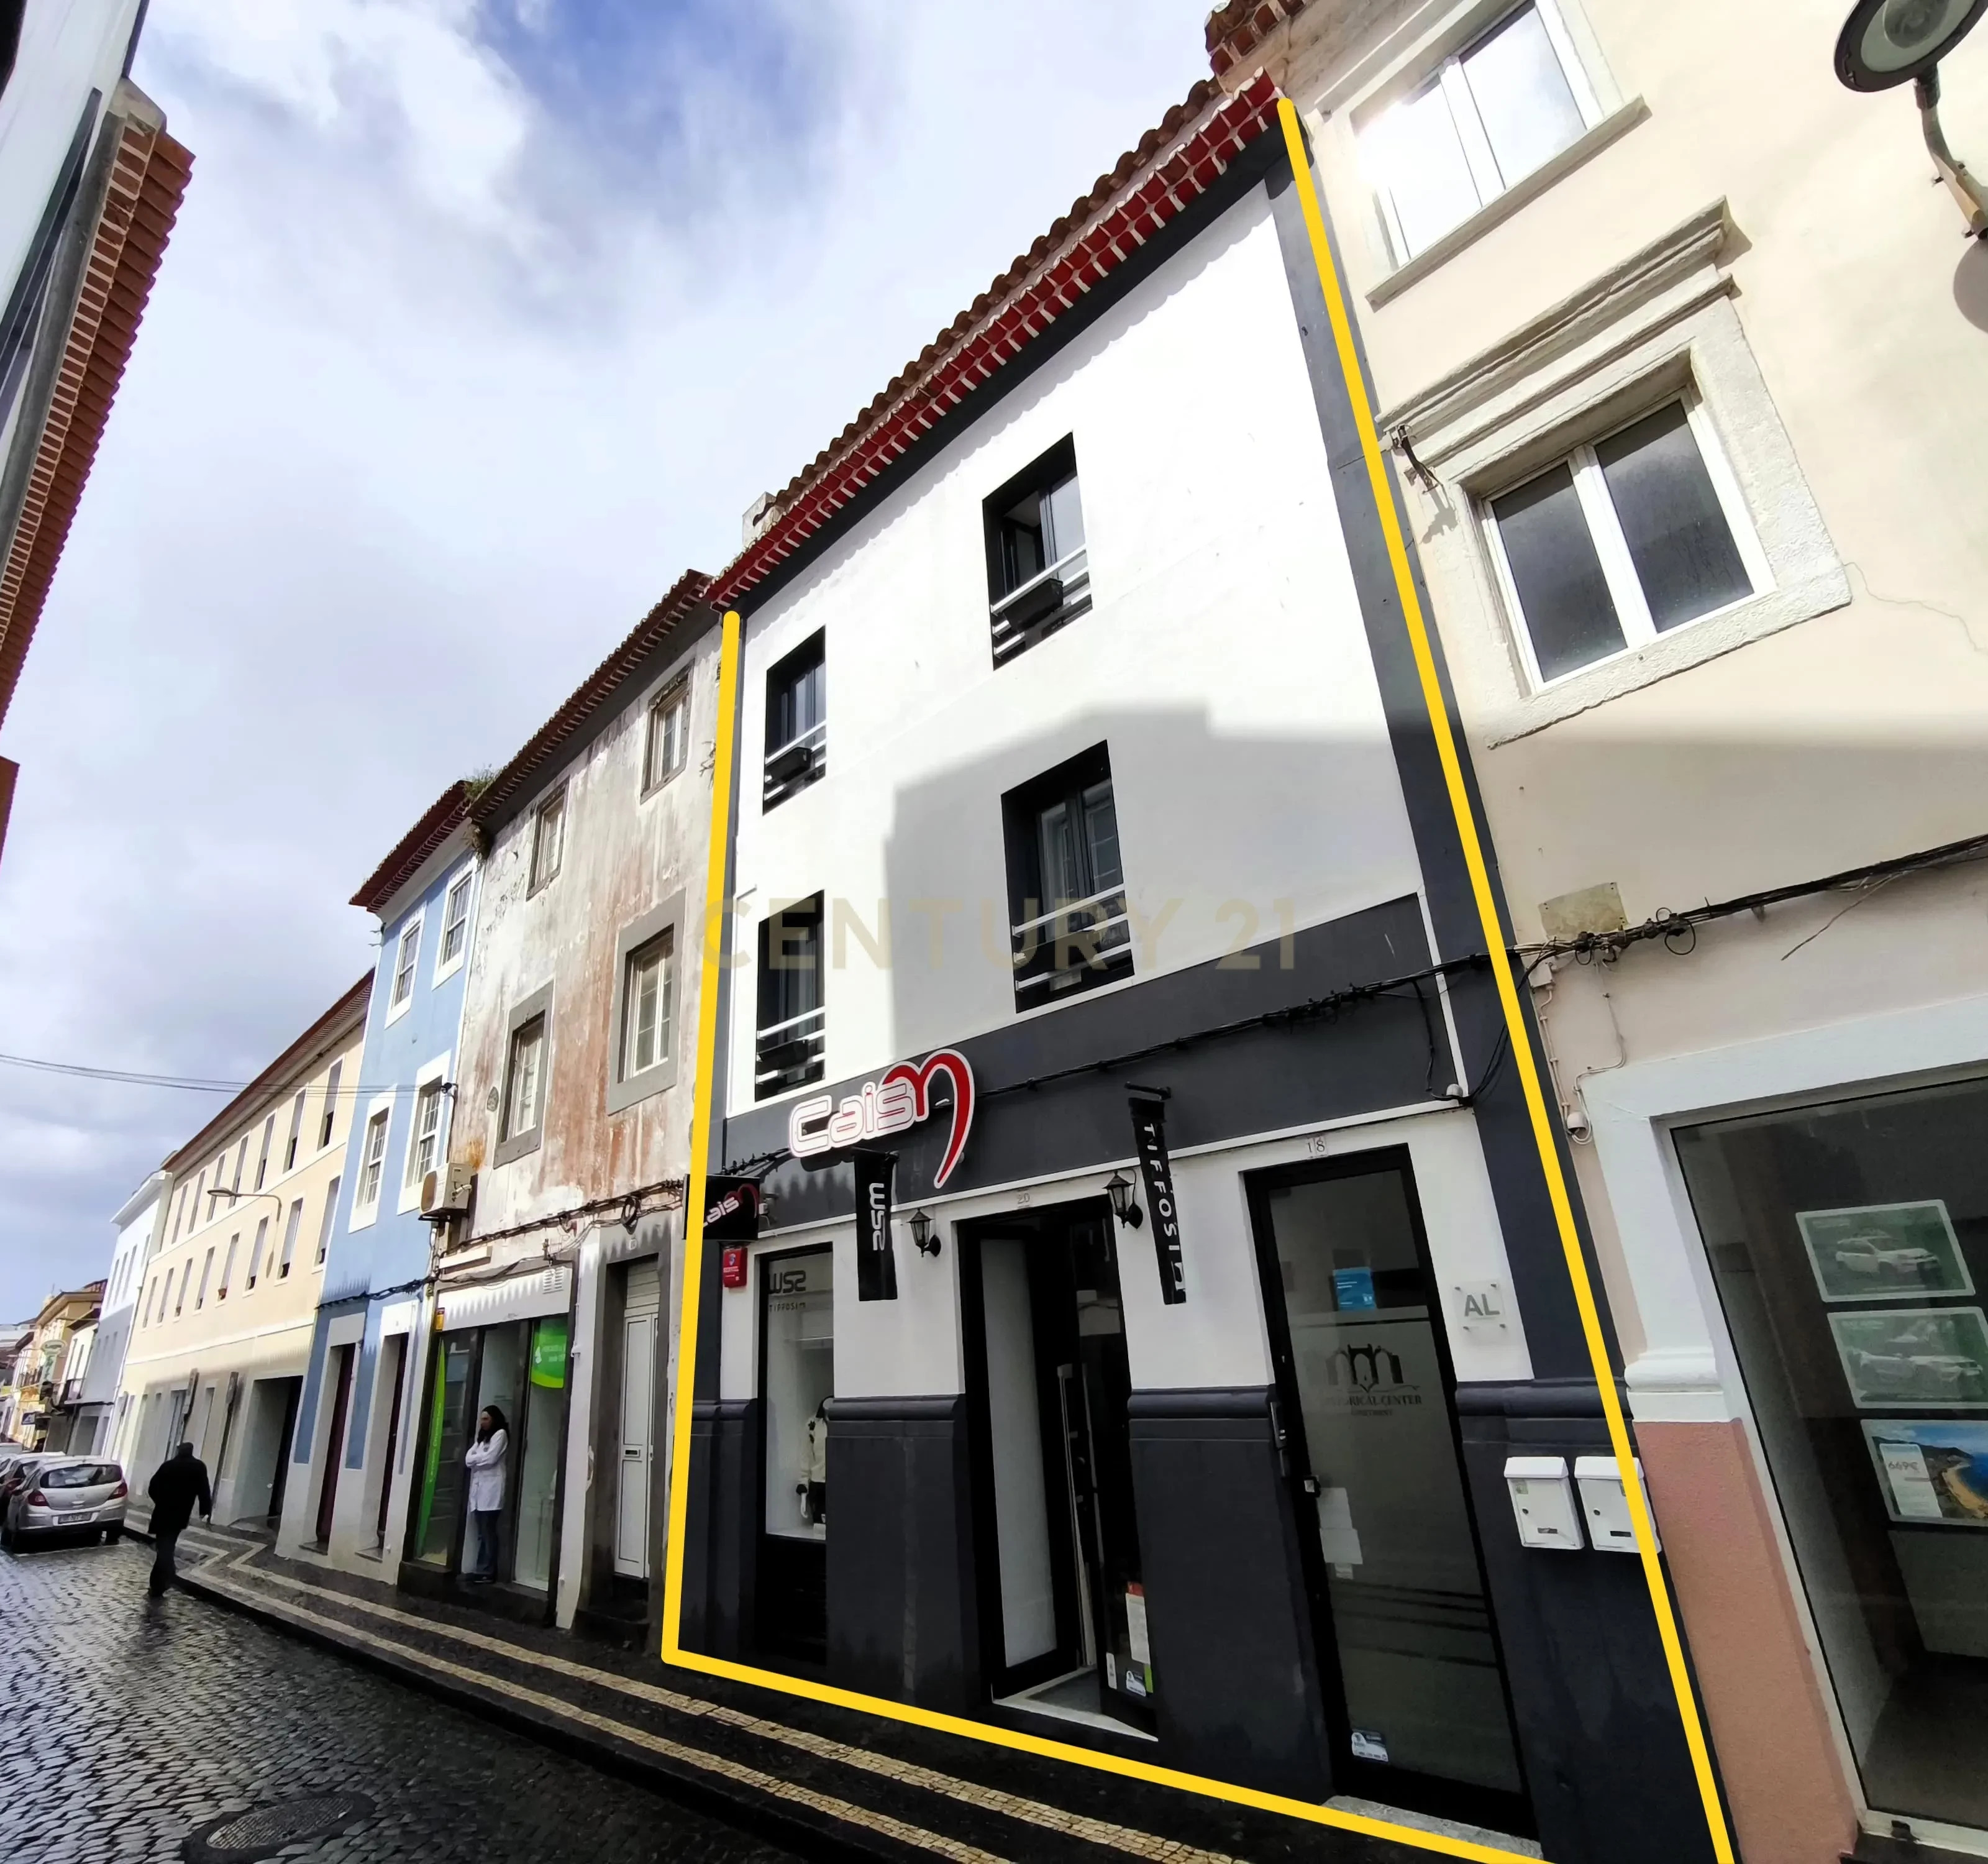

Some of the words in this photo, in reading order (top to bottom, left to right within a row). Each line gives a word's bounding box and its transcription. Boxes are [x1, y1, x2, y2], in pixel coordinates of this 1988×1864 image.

[1306, 1140, 1325, 1153] 18
[1144, 1123, 1180, 1251] TIFFOSI
[1017, 1192, 1030, 1204] 20
[1464, 1292, 1501, 1317] AL
